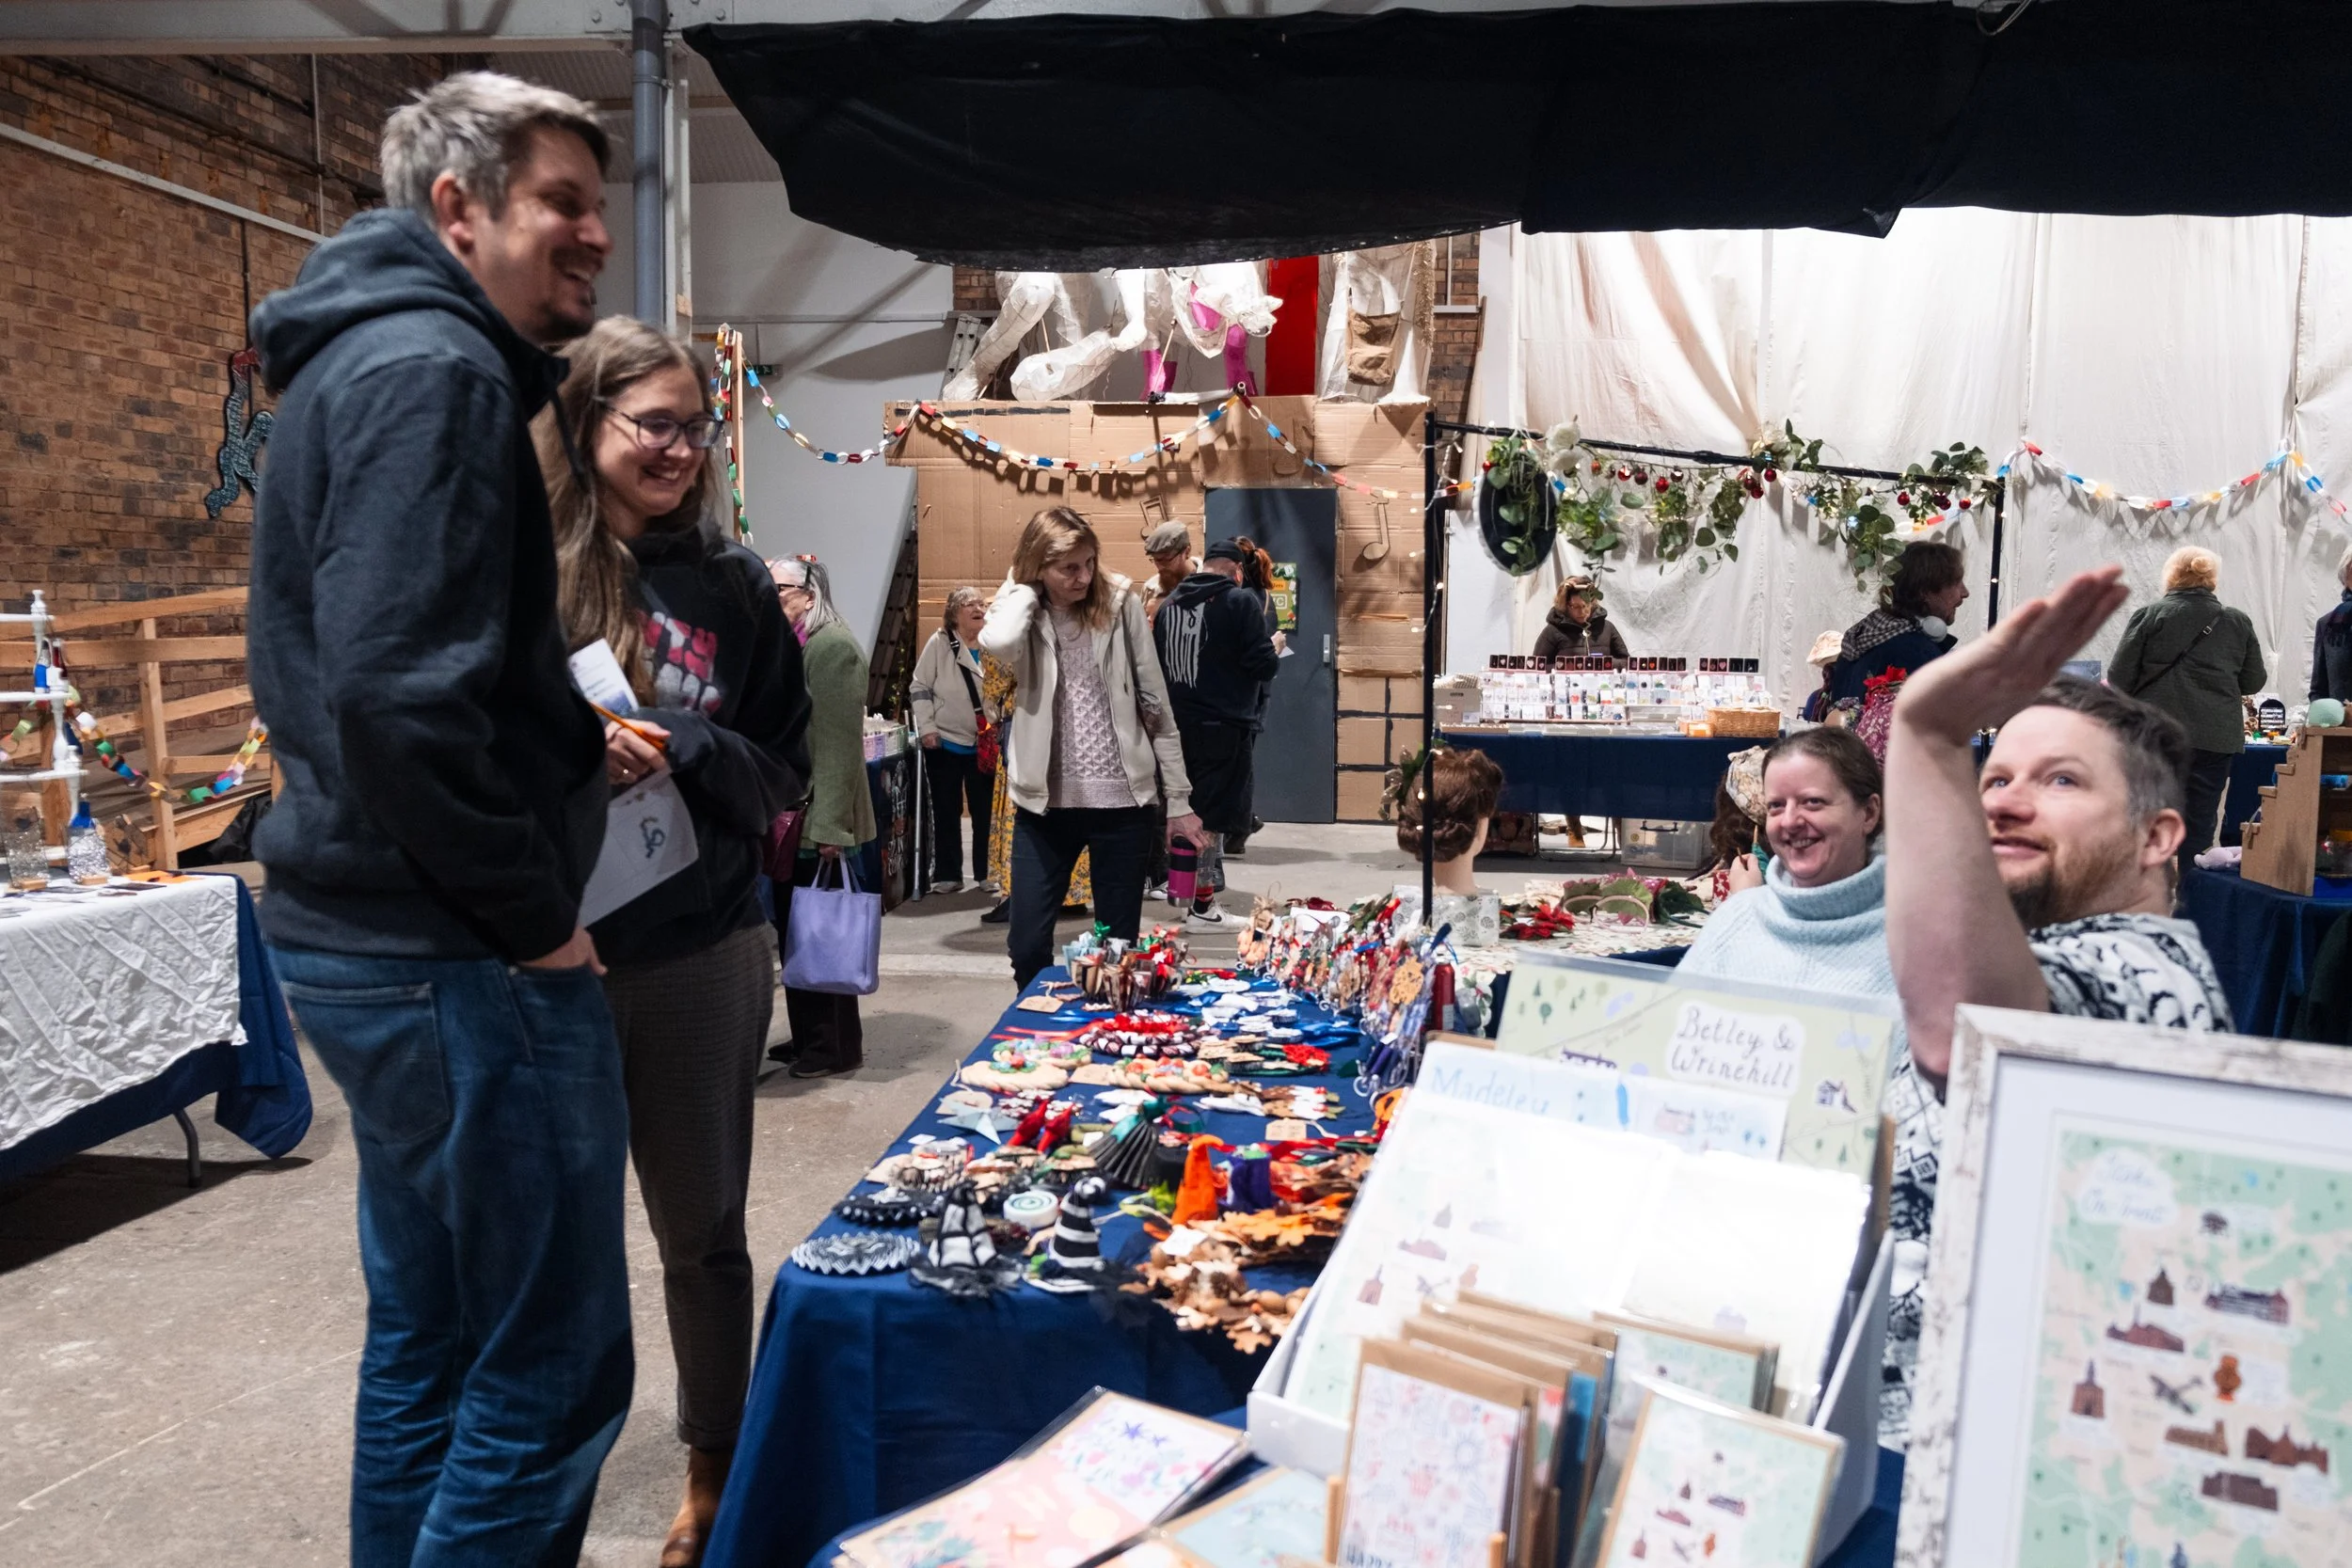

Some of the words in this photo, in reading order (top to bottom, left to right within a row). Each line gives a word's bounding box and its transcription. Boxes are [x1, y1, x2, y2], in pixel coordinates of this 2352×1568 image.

[1677, 1006, 1763, 1059] Betley
[1772, 1022, 1795, 1052] &
[1672, 1043, 1794, 1088] Wrinehill
